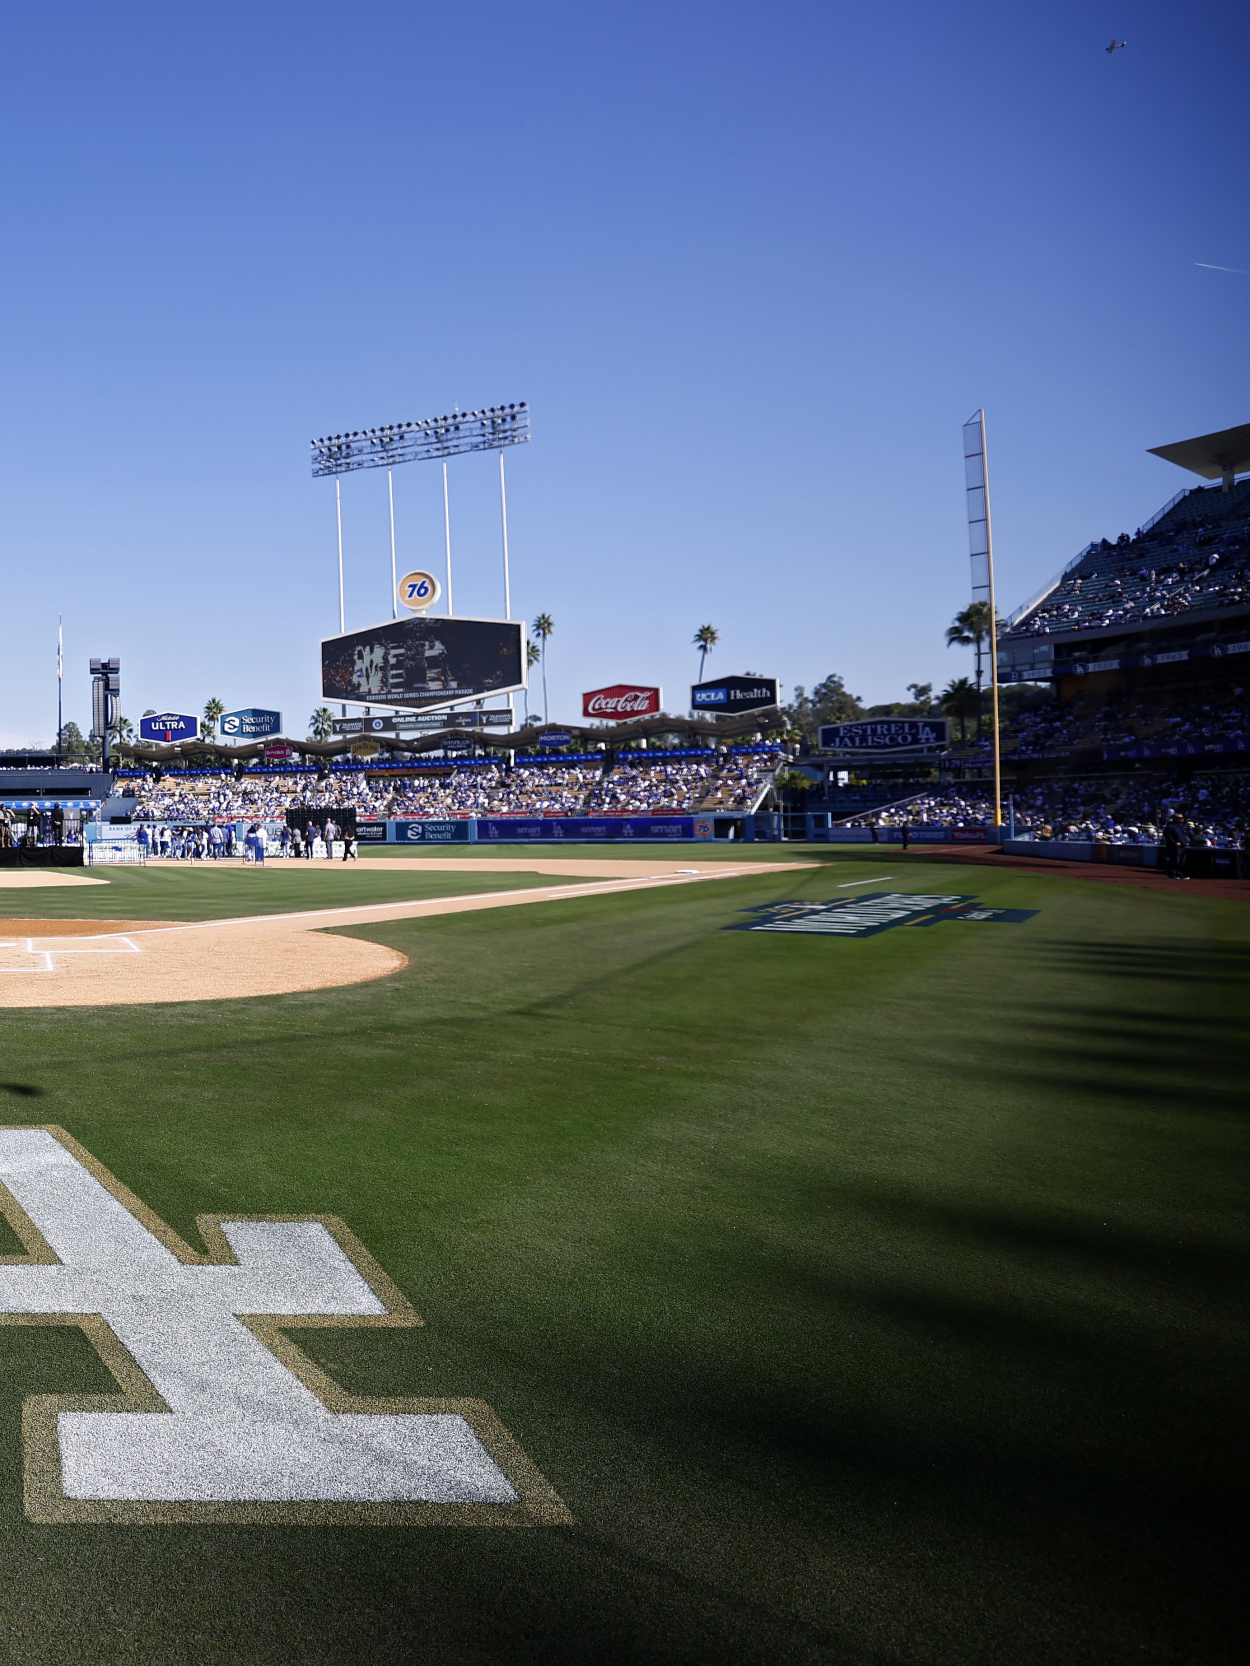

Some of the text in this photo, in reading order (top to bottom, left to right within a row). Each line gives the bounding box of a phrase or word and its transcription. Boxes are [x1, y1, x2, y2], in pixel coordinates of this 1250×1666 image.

[406, 580, 430, 598] 76
[420, 690, 454, 698] CHAMPIONSHIP
[695, 688, 771, 702] UCLA Health
[242, 715, 275, 724] Security
[417, 714, 448, 722] AUCTION
[151, 721, 185, 730] ULTRA
[243, 723, 272, 733] Benefit
[830, 733, 912, 747] JALISCO
[425, 823, 456, 832] Security
[581, 825, 606, 833] smart
[651, 823, 683, 833] smart
[697, 823, 710, 832] 76
[893, 831, 918, 839] TOO
